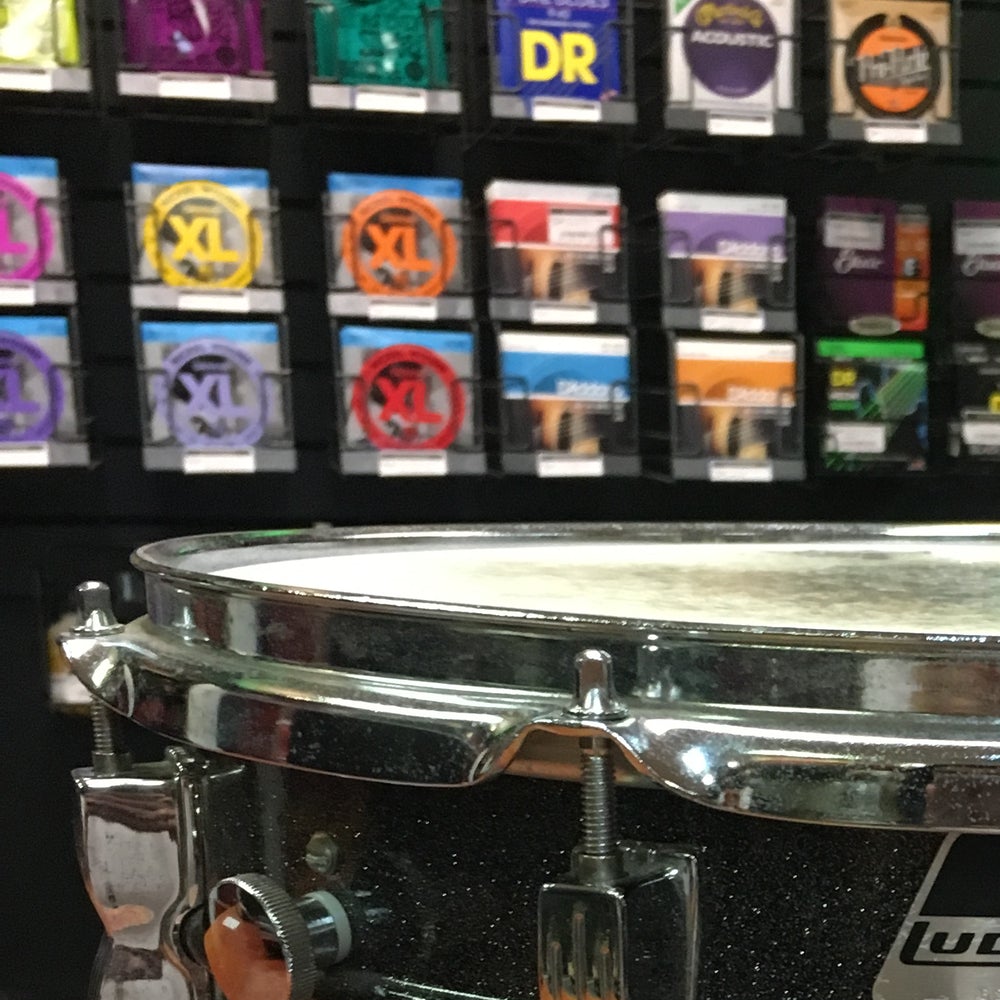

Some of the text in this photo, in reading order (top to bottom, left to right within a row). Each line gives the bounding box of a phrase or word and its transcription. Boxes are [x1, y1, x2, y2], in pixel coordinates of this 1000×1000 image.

[521, 29, 599, 85] DR
[690, 30, 774, 48] ACOUSTIC
[168, 214, 239, 262] XL
[367, 223, 433, 272] XL
[177, 373, 250, 417] XL
[378, 376, 443, 424] XL
